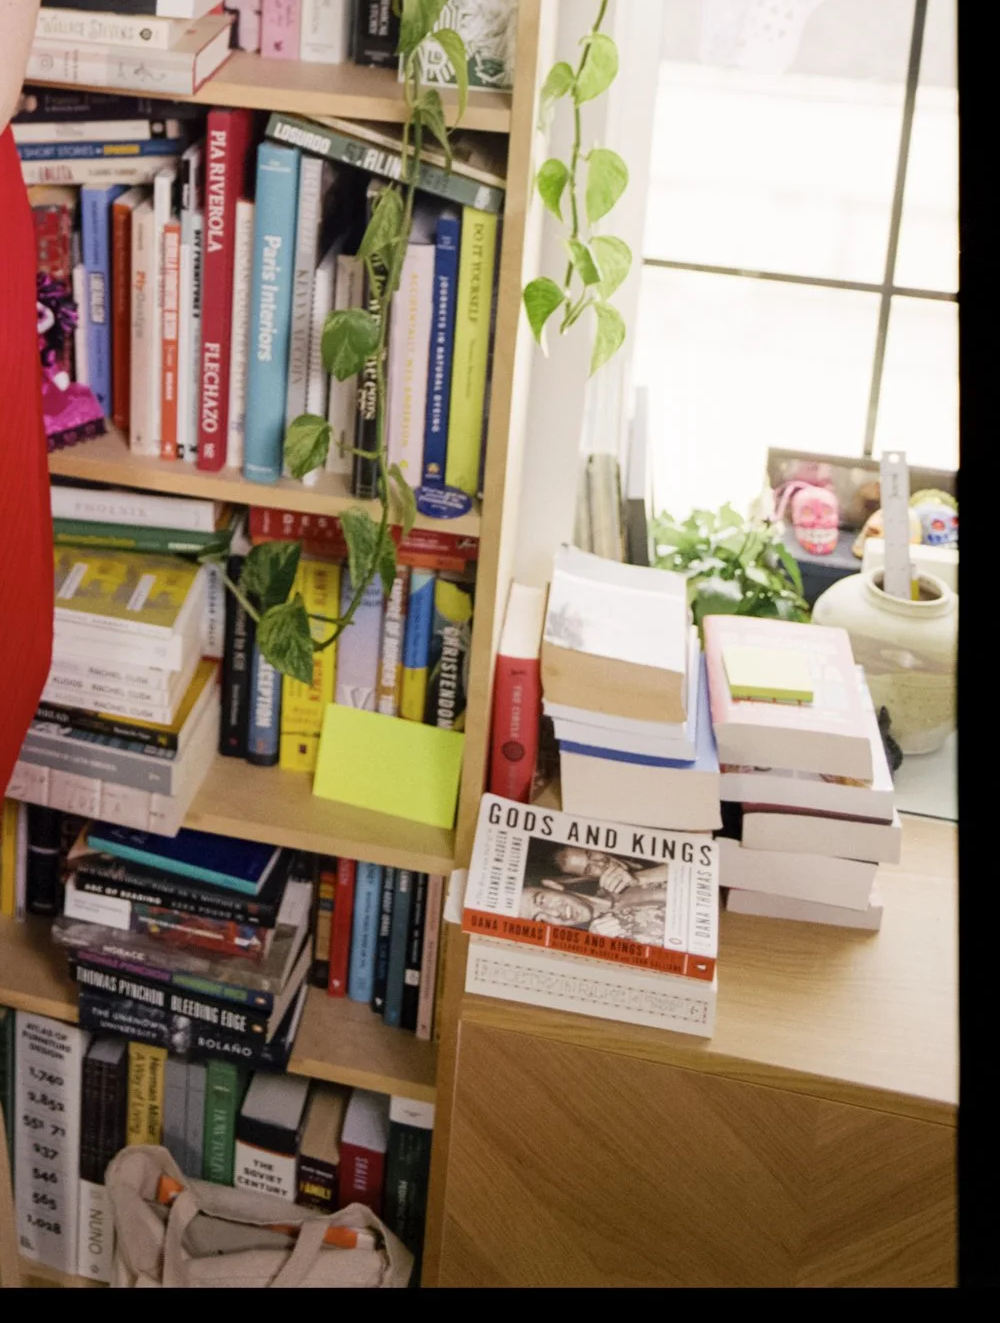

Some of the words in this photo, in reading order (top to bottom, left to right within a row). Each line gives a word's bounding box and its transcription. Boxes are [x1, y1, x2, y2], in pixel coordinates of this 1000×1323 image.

[39, 16, 85, 37] WALLACE
[88, 19, 135, 41] STEVENS
[23, 146, 53, 158] SHORT
[57, 144, 95, 157] STORIES
[209, 130, 227, 162] PIA
[273, 122, 332, 155] LOSURDO
[207, 162, 225, 253] RIVEROLA
[472, 223, 485, 242] DO
[260, 236, 282, 281] Paris
[471, 244, 483, 258] IT
[437, 275, 450, 329] JOURNEYS
[467, 261, 482, 324] YOURSELF
[257, 284, 279, 362] Interiors
[436, 331, 447, 343] IN
[403, 359, 416, 382] WES
[433, 346, 447, 392] NATURAL
[201, 342, 221, 434] FLECHAZO
[400, 387, 414, 448] ANDERSON
[431, 394, 444, 434] DYEING
[89, 666, 123, 681] RACHEL
[91, 683, 125, 696] RACHEL
[93, 699, 128, 713] RACHEL
[488, 802, 555, 837] GODS
[567, 821, 618, 849] AND
[631, 832, 712, 867] KINGS
[507, 837, 523, 874] GALLIANO
[84, 883, 102, 893] ABC
[104, 887, 118, 896] OF
[119, 888, 163, 905] READING
[486, 867, 503, 909] ALEXANDER
[504, 877, 518, 895] JOHN
[695, 871, 712, 908] THOMAS
[471, 915, 498, 931] DANA
[503, 921, 545, 941] THOMAS
[694, 912, 711, 939] DANA
[552, 928, 580, 943] GODS
[584, 934, 606, 948] AND
[610, 938, 643, 956] KINGS
[76, 965, 118, 989] THOMAS
[118, 977, 165, 1007] PYNCHON
[170, 995, 219, 1028] BLEEDING
[220, 1009, 247, 1032] EDGE
[91, 1006, 110, 1018] THE
[112, 1012, 168, 1032] UNKNOWN
[22, 1029, 72, 1054] FURNITURE
[55, 1032, 68, 1042] OF
[28, 1042, 65, 1061] DESIGN
[28, 1065, 65, 1087] 1,740
[148, 1056, 160, 1102] Herman
[148, 1103, 160, 1137] Miller
[243, 1167, 284, 1185] SOVIET
[253, 1159, 275, 1172] THE
[237, 1176, 288, 1197] CENTURY
[87, 1208, 102, 1256] NUNO
